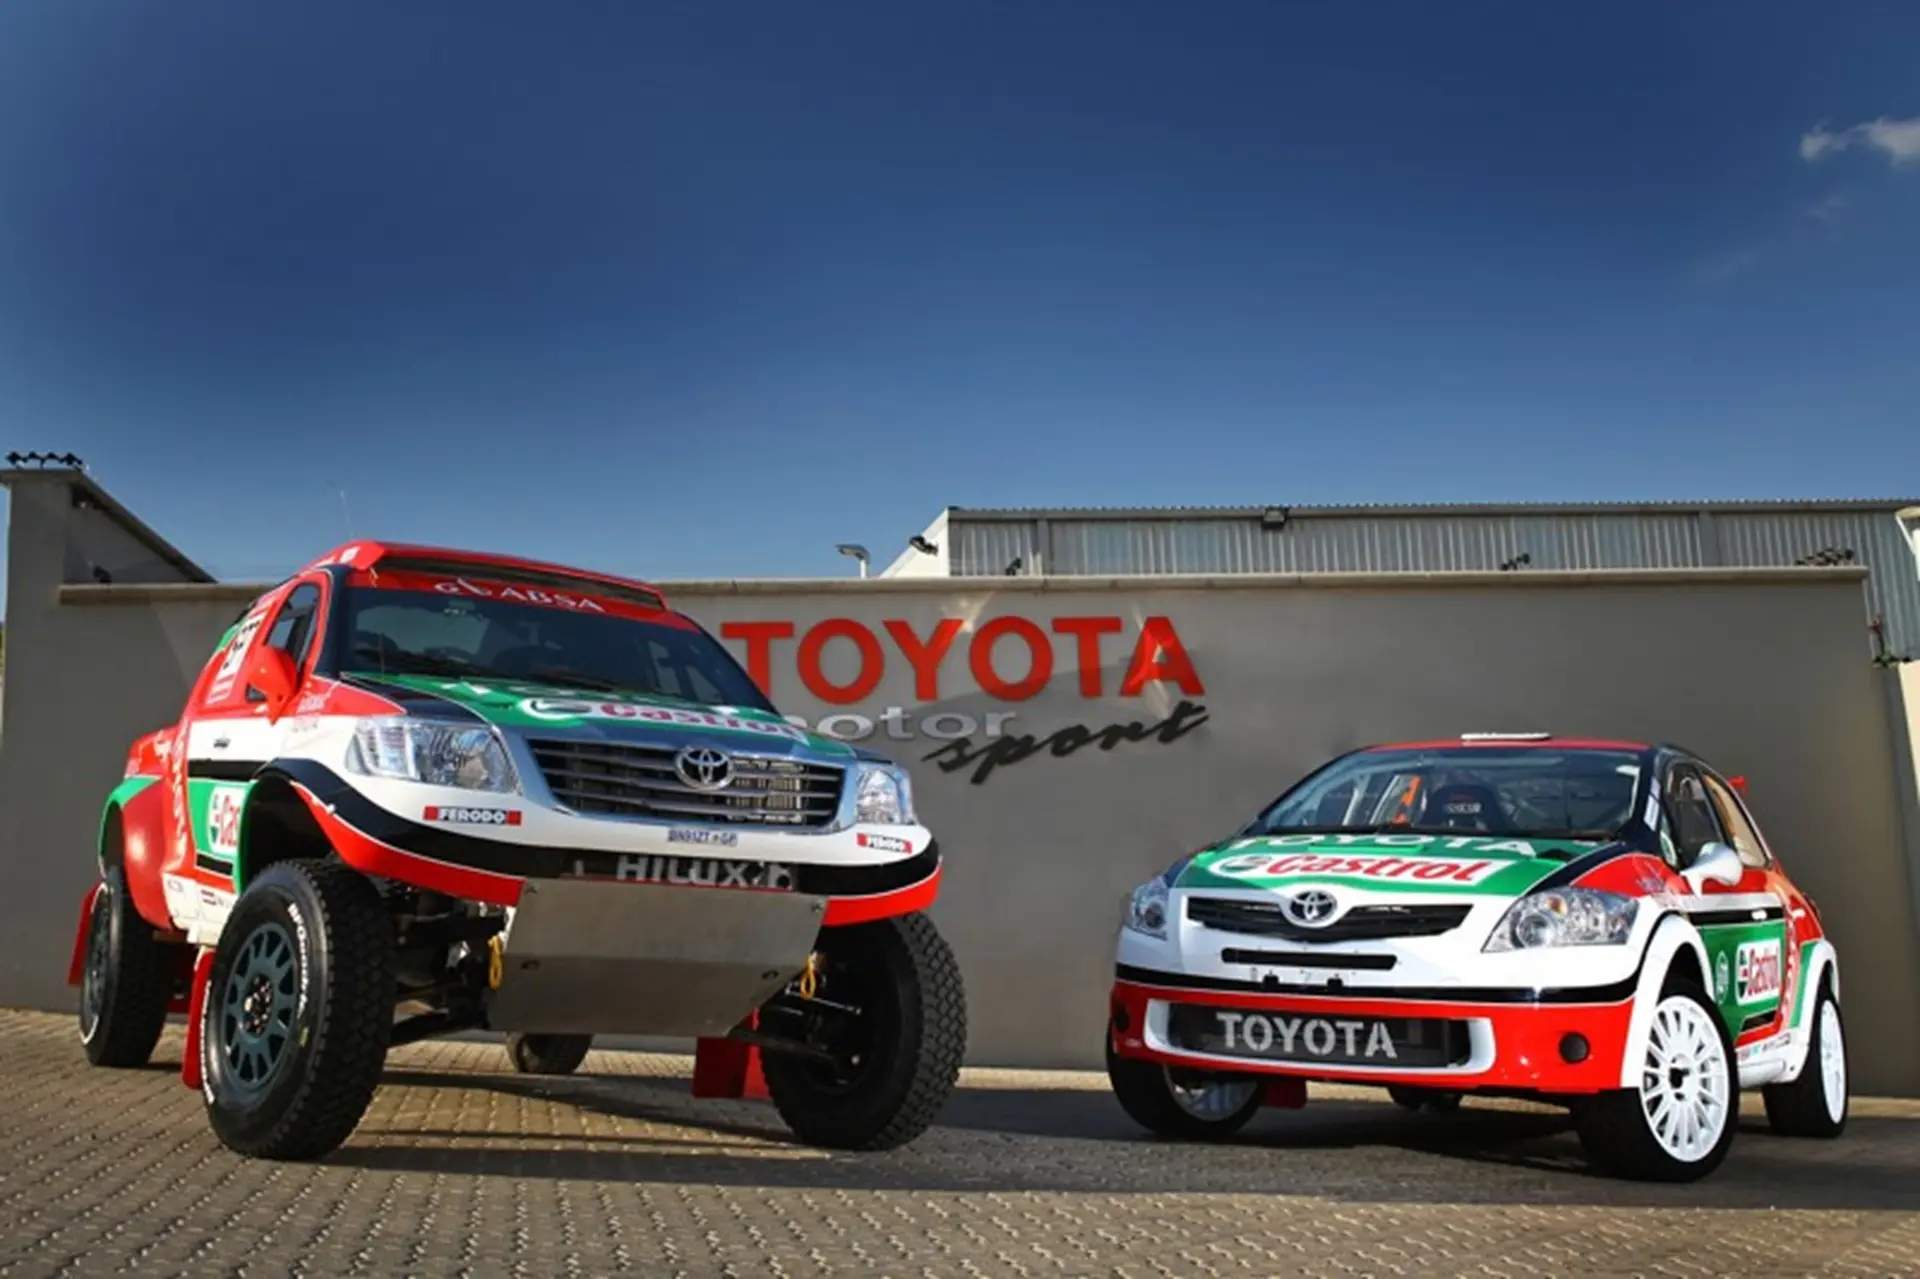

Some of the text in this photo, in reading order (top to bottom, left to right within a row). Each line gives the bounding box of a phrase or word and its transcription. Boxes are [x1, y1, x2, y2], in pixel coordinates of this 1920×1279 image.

[721, 616, 1205, 704] TOYOTA
[922, 699, 1210, 786] sport
[439, 807, 506, 824] FERODO
[1266, 855, 1491, 881] Castrol
[1215, 1011, 1399, 1060] TOYOTA
